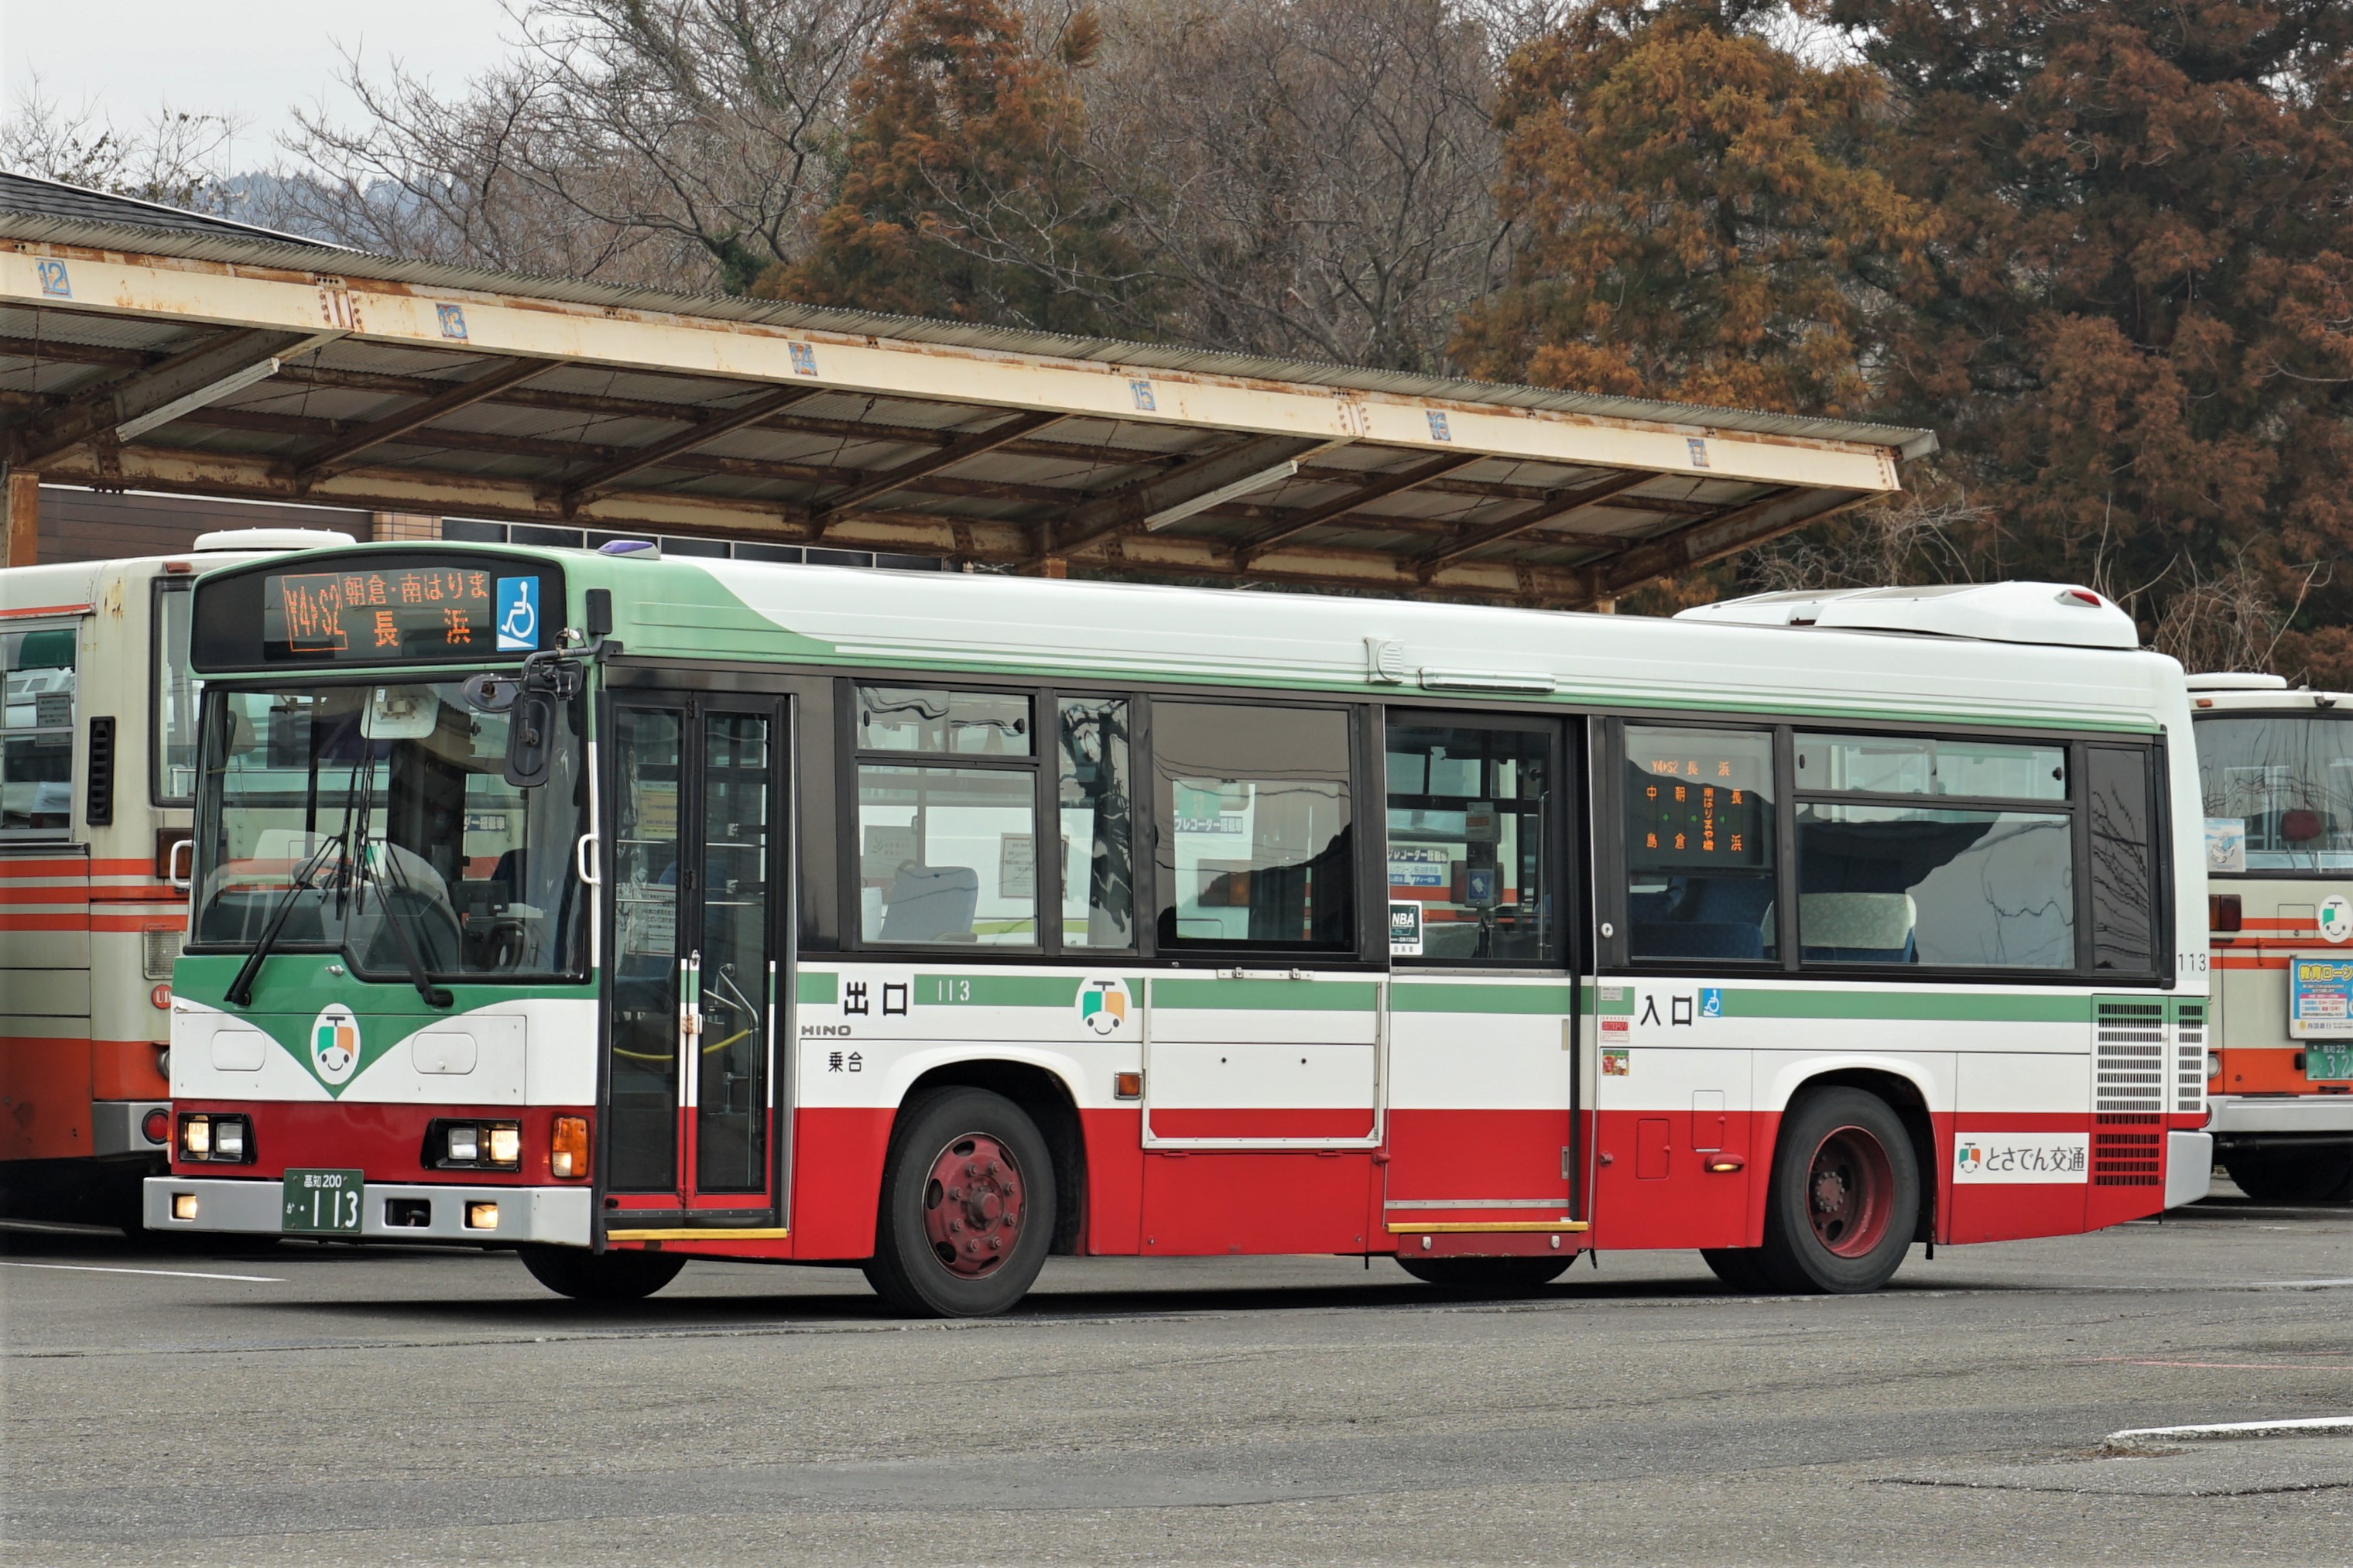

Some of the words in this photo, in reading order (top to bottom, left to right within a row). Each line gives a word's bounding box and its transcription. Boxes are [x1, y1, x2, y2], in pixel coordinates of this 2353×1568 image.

[39, 262, 69, 293] 12
[438, 306, 467, 337] 13
[790, 346, 817, 373] 14
[1131, 382, 1155, 409] 15
[1427, 414, 1450, 440] 16
[344, 572, 488, 606] 朝倉・南はりま
[1392, 912, 1415, 927] NBA
[2177, 953, 2207, 973] 113
[844, 981, 908, 1016] 出口
[938, 979, 971, 1001] 113
[1639, 994, 1693, 1027] 入口
[801, 1024, 852, 1036] HINO
[828, 1050, 864, 1073] 乗合
[1985, 1145, 2086, 1173] とさでん交通
